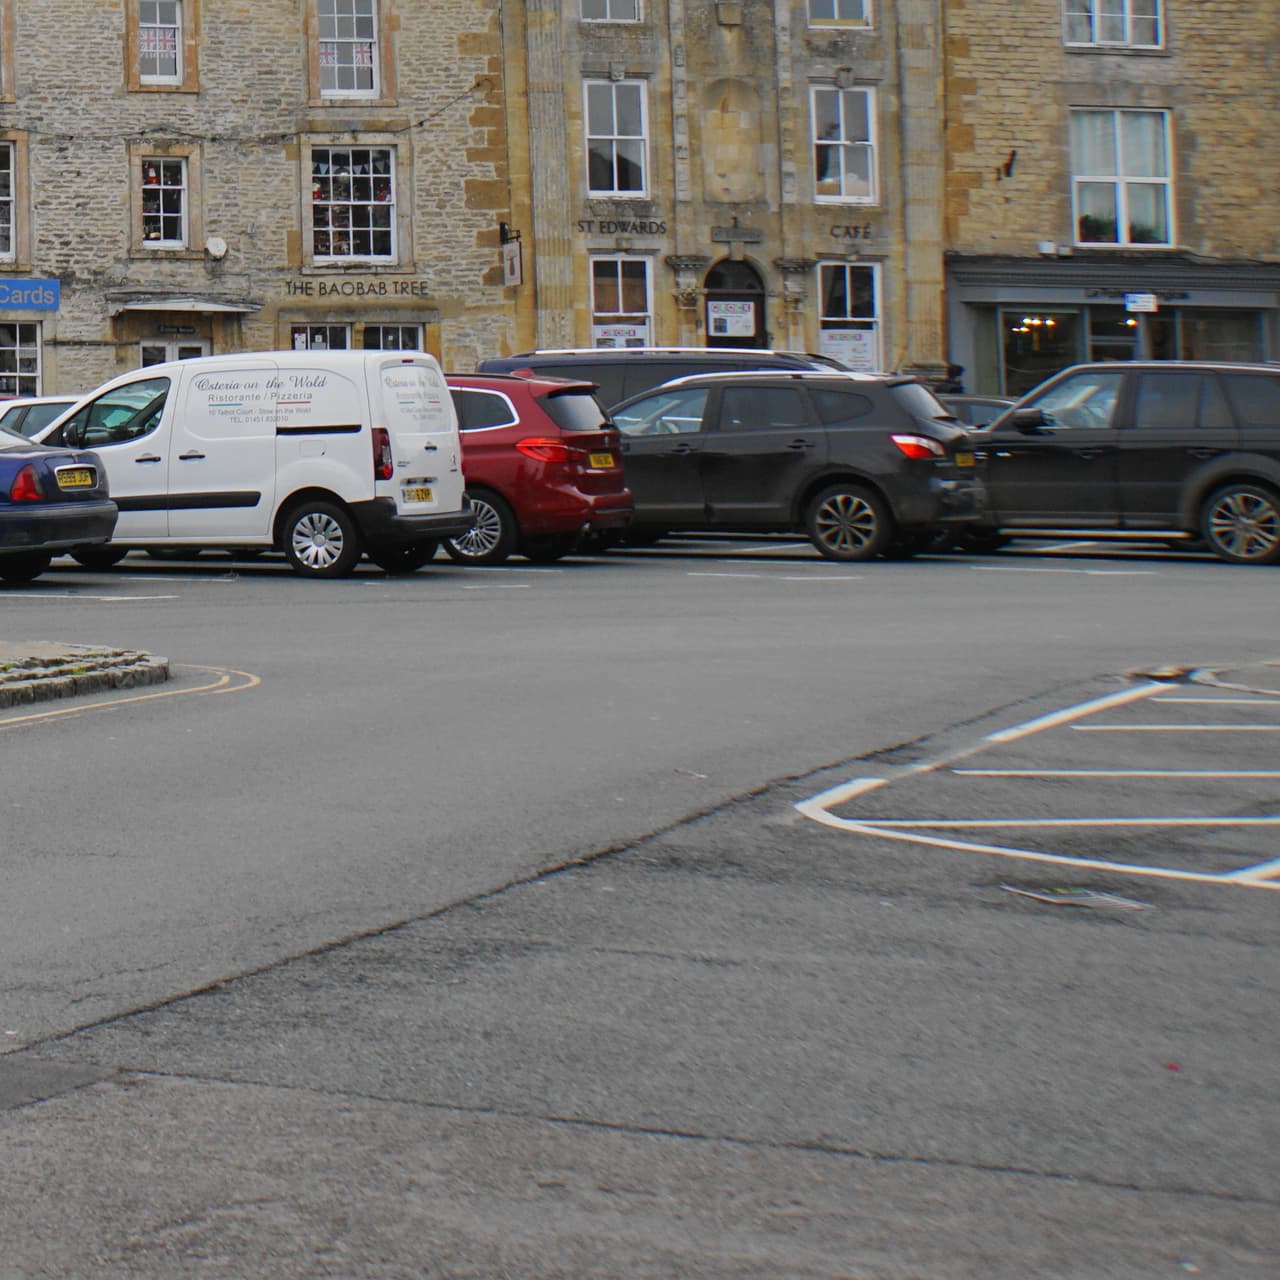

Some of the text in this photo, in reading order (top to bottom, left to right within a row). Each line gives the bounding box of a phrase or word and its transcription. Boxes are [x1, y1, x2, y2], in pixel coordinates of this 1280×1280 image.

[577, 221, 667, 234] ST EDWARDS
[830, 223, 872, 239] CAFÉ
[285, 281, 429, 296] THE BAOBAB TREE
[195, 378, 241, 391] Osteria
[265, 376, 285, 389] the
[289, 376, 327, 388] Wold
[208, 394, 261, 402] Ristorante
[270, 392, 313, 400] Pizzeria
